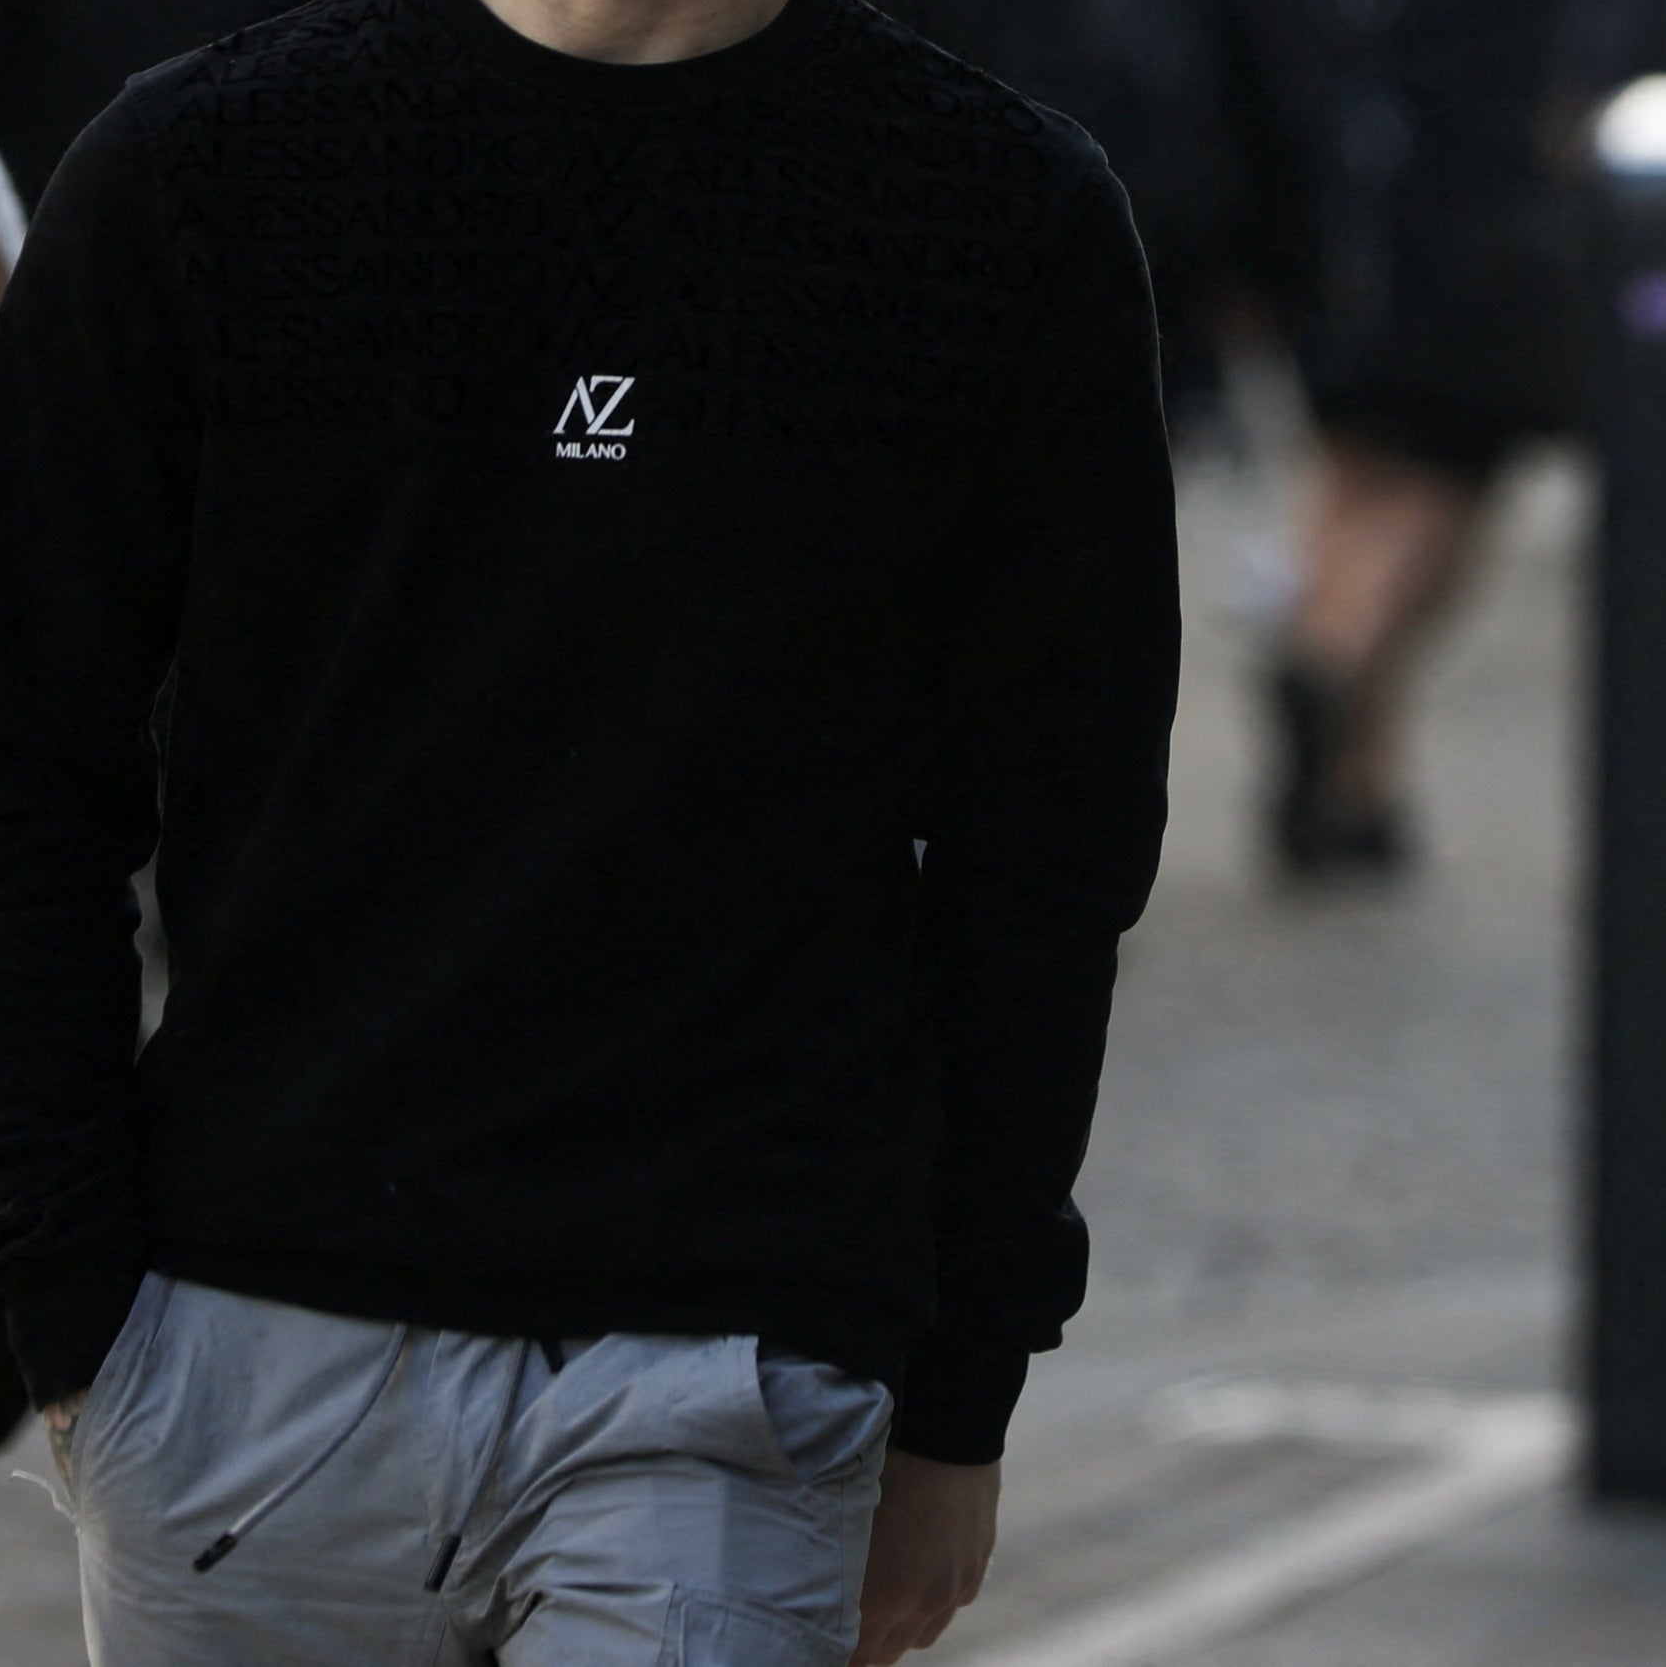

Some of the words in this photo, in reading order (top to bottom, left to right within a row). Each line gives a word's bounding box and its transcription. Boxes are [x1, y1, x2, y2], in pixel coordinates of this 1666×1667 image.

[166, 132, 544, 185] ALESSANDRO
[553, 375, 635, 436] AZ
[556, 442, 627, 460] MILANO
